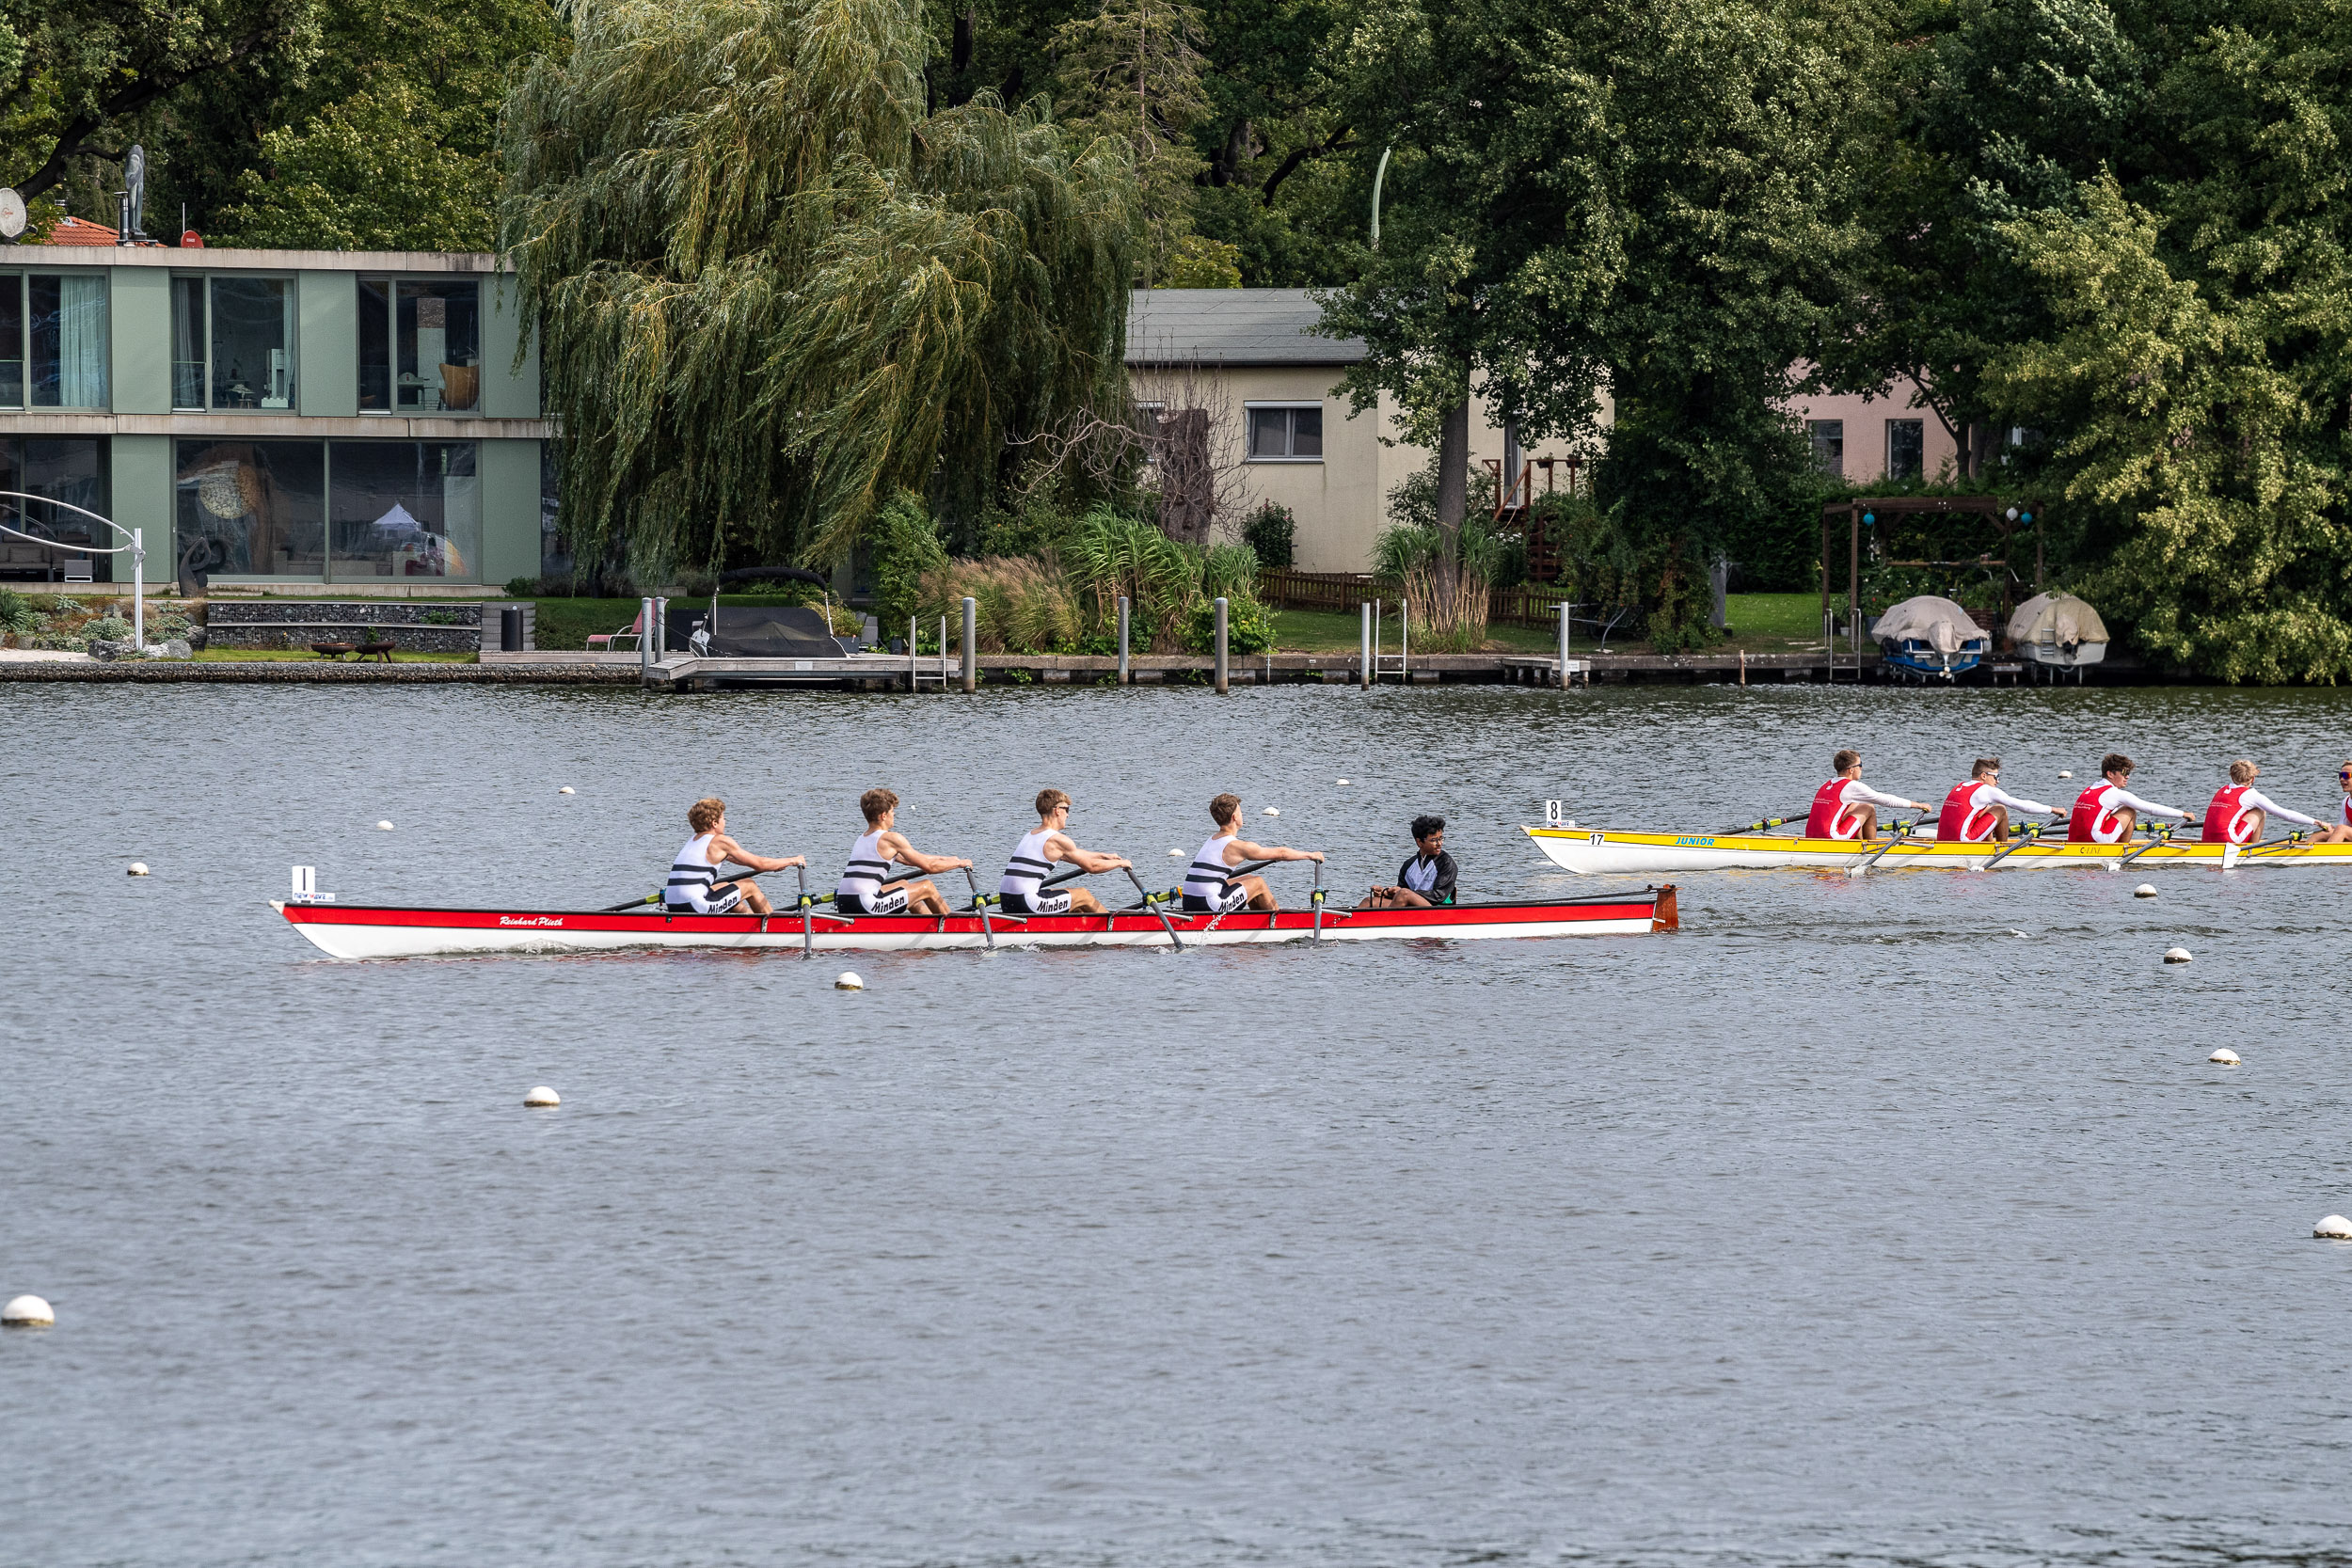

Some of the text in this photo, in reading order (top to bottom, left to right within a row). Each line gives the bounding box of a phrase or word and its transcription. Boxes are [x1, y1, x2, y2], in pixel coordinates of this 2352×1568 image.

[1550, 801, 1558, 819] 8
[1590, 833, 1604, 845] 17
[1675, 836, 1715, 847] JUNIOR
[707, 895, 738, 913] Minden
[871, 896, 905, 913] Minden
[1037, 899, 1069, 912] Minden
[1217, 893, 1245, 912] Minden
[500, 916, 537, 926] Reinhard
